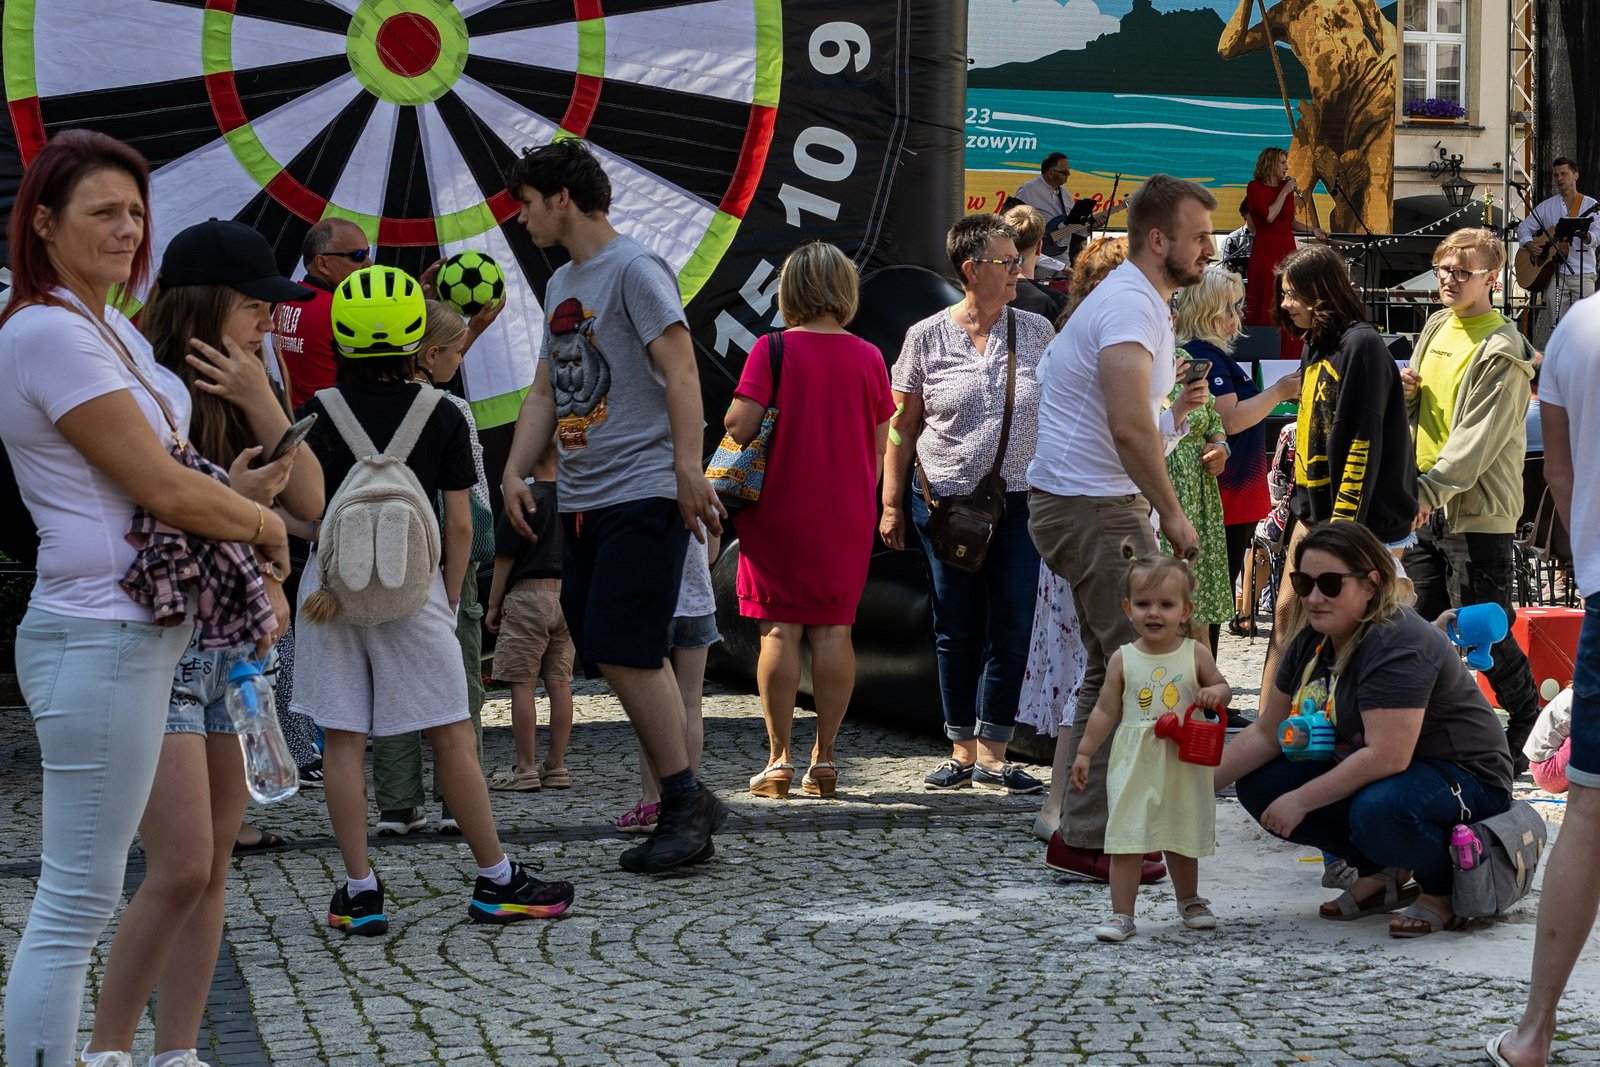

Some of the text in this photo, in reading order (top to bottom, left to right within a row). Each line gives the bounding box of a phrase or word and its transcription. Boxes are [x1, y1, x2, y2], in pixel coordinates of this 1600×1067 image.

[965, 107, 991, 125] 23
[965, 135, 1038, 154] zowym
[778, 126, 858, 228] 10
[967, 196, 987, 211] w
